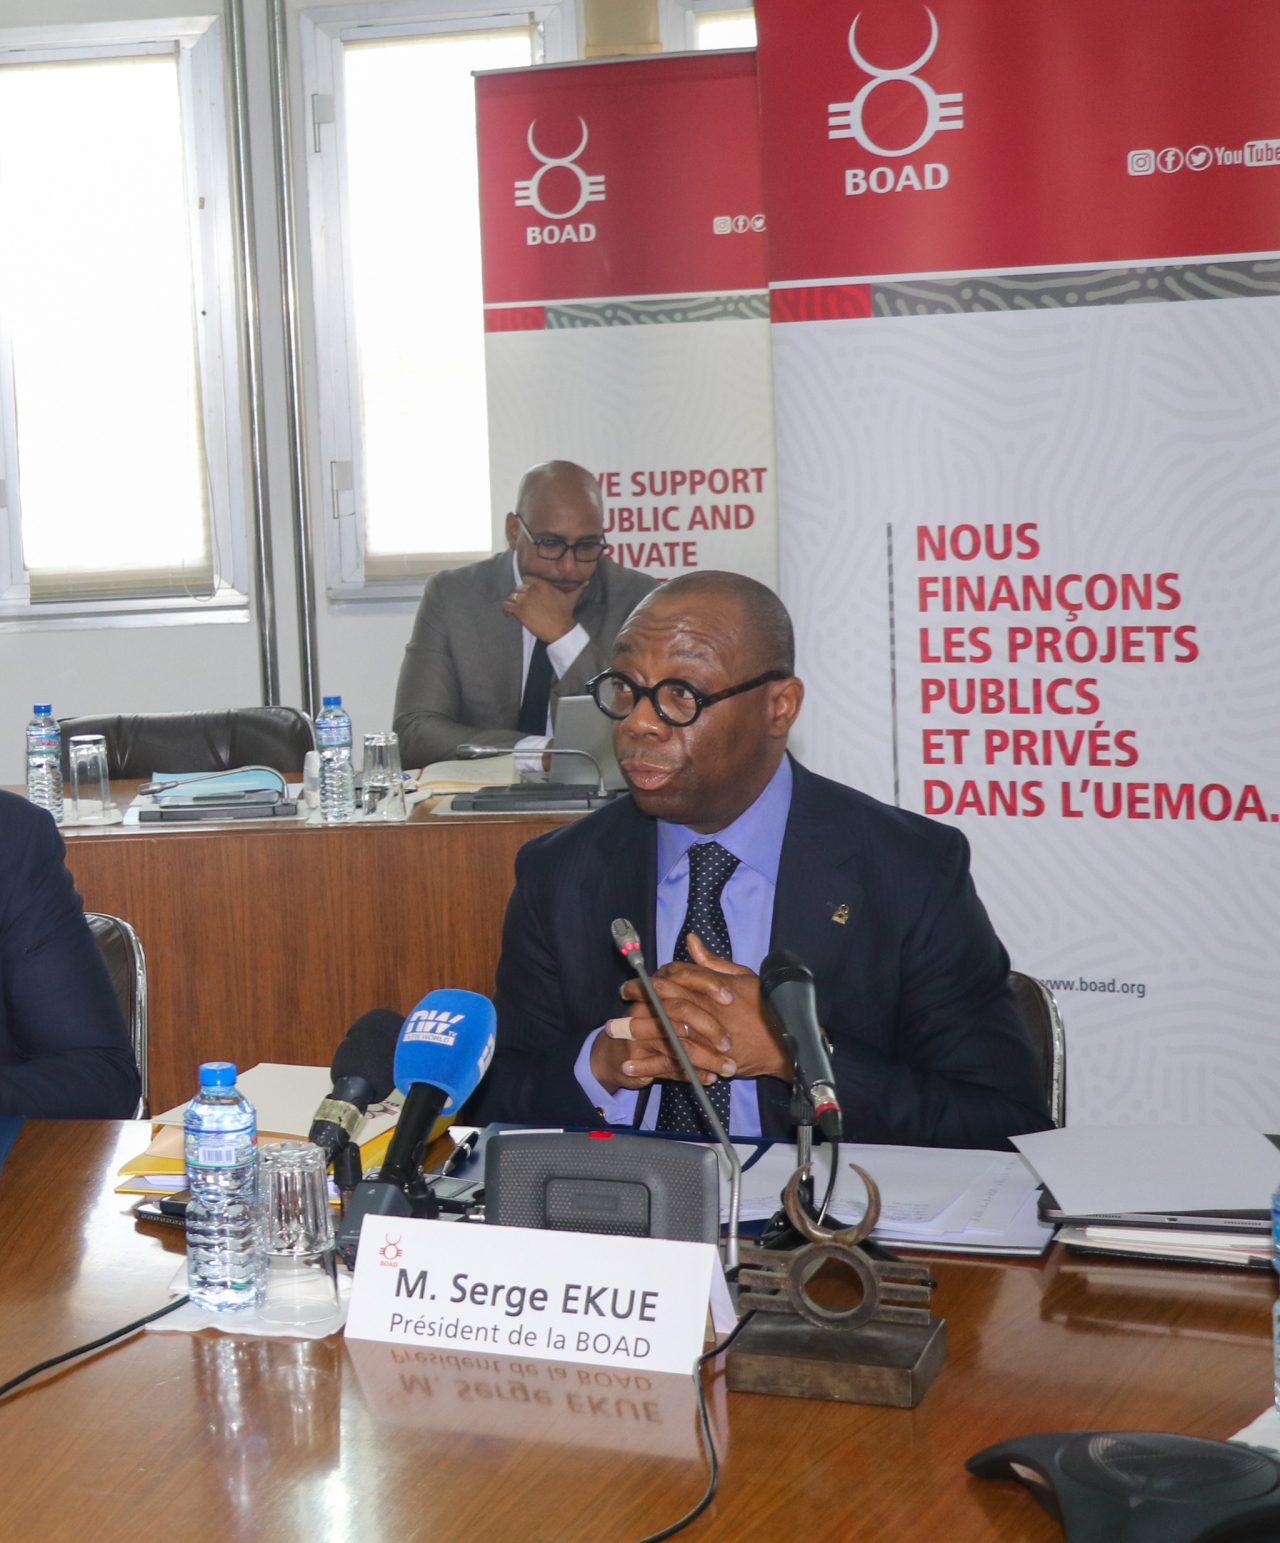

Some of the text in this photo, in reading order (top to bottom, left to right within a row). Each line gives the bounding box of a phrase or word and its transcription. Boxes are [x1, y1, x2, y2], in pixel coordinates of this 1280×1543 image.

[845, 163, 949, 196] BOAD
[526, 223, 597, 245] BOAD
[596, 467, 767, 498] E SUPPORT
[603, 504, 755, 533] UBLIC AND
[917, 522, 1040, 561] NOUS
[917, 572, 1182, 622] FINANÇONS
[919, 625, 1200, 664] LES PROJETS
[921, 677, 1100, 715] PUBLICS
[922, 720, 1139, 767] ET PRIVÉS
[923, 779, 1046, 817] DANS
[1041, 976, 1146, 998] ww.boad.org
[395, 1268, 659, 1322] M. Serge EKUE
[389, 1313, 651, 1358] Président de la BOAD
